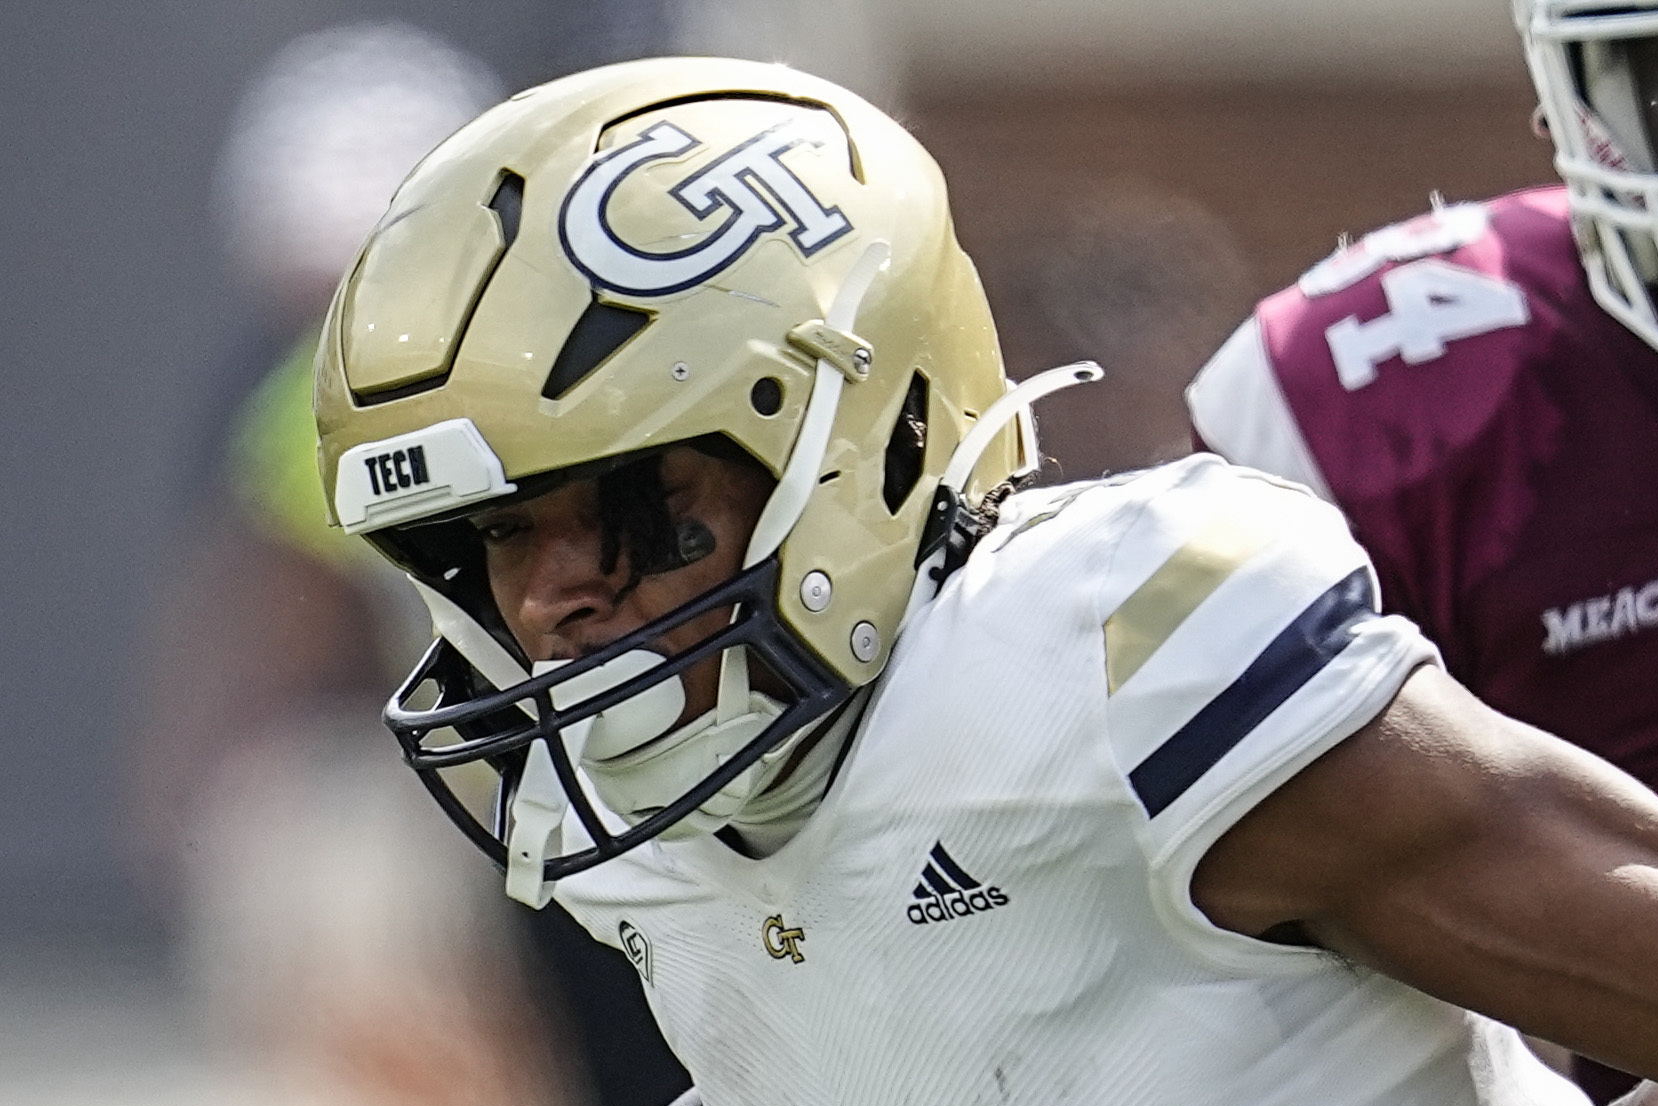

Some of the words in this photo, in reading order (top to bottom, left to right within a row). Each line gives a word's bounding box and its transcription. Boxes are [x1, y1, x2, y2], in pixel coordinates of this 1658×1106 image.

[1300, 203, 1530, 391] 34
[364, 444, 430, 497] TECH
[906, 882, 1011, 926] adidas
[761, 914, 806, 964] GT
